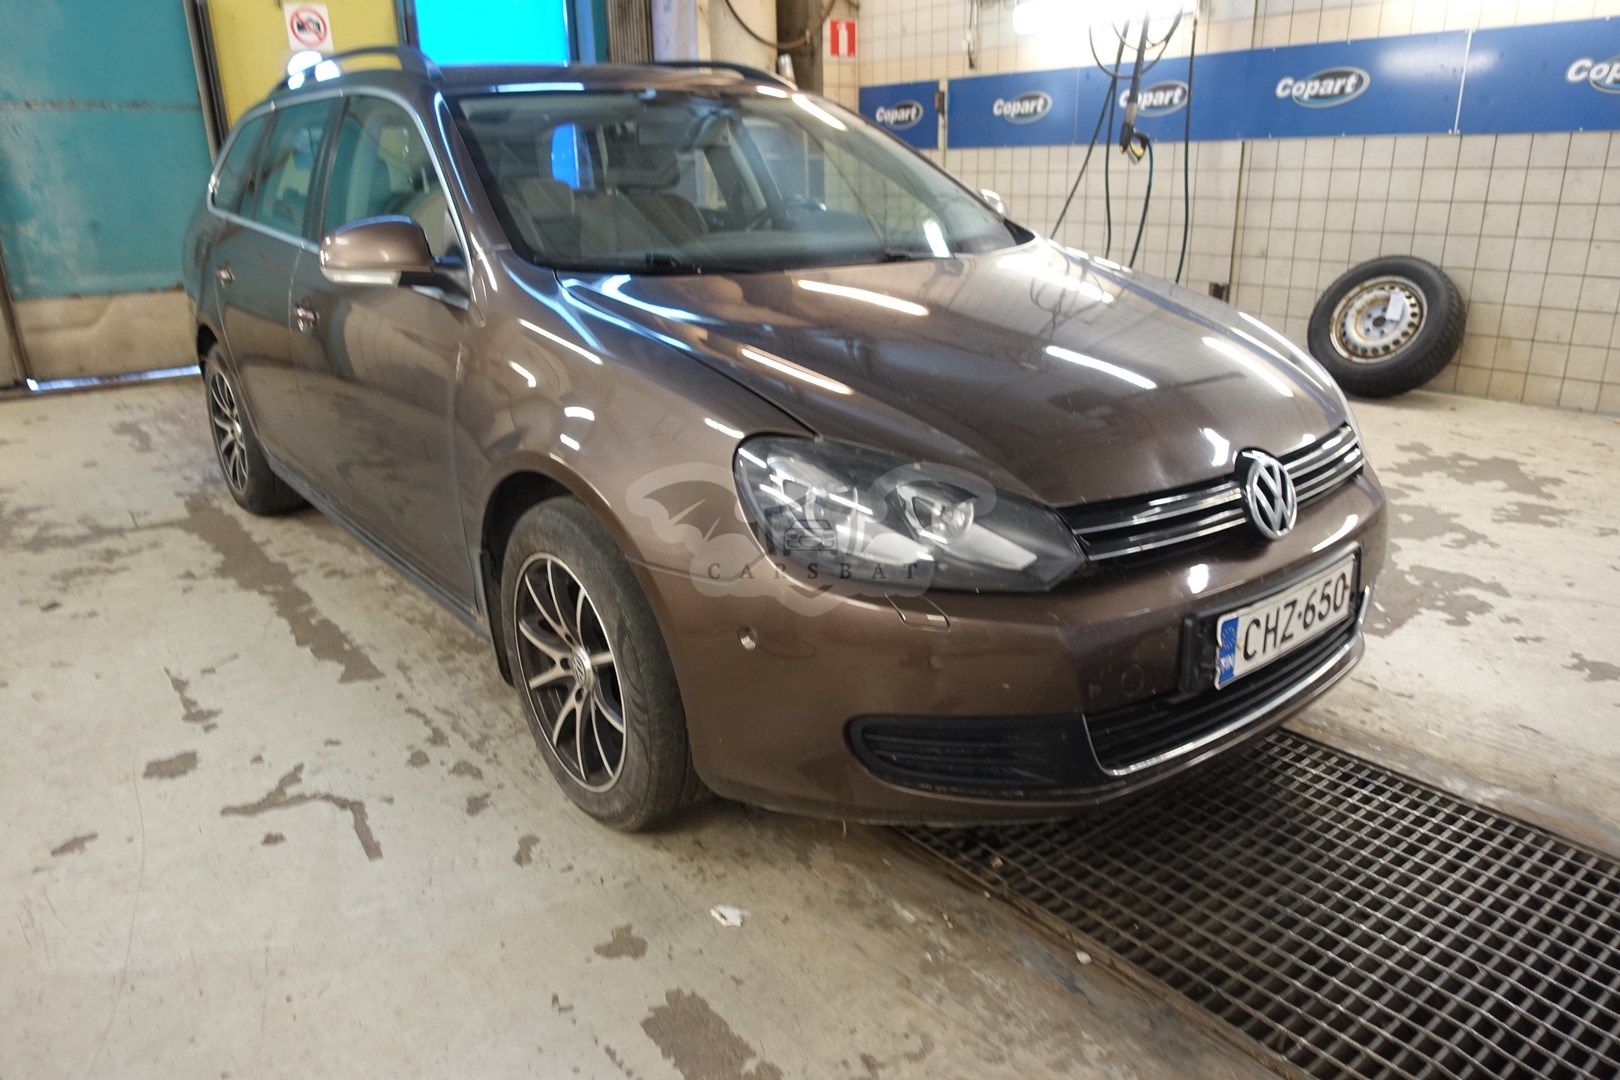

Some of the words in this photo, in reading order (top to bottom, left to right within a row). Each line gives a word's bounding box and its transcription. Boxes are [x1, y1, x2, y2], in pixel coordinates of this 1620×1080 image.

[1275, 74, 1358, 100] Copart
[876, 106, 916, 124] Copart
[993, 98, 1043, 118] Copart
